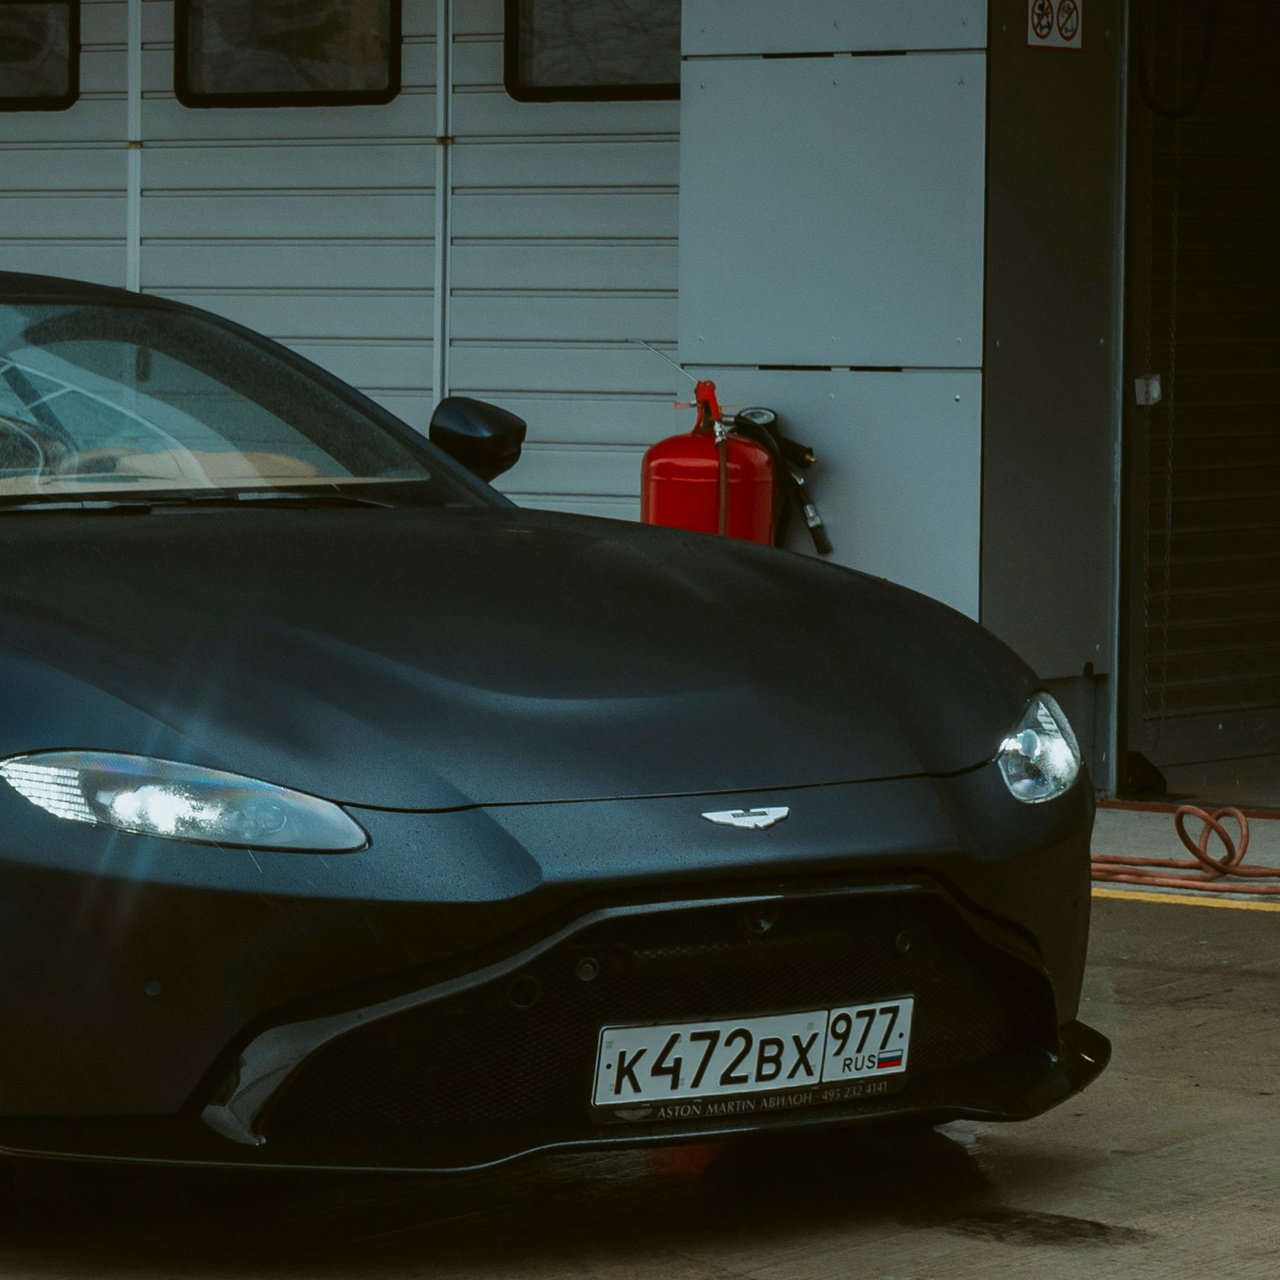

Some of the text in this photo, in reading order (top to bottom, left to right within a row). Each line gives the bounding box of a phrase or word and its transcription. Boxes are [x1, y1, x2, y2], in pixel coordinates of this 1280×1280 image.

[830, 1006, 900, 1057] 977
[843, 1054, 876, 1073] RUS
[658, 1081, 888, 1118] ASTON MARTIN АВИЛОН 495 232 4141
